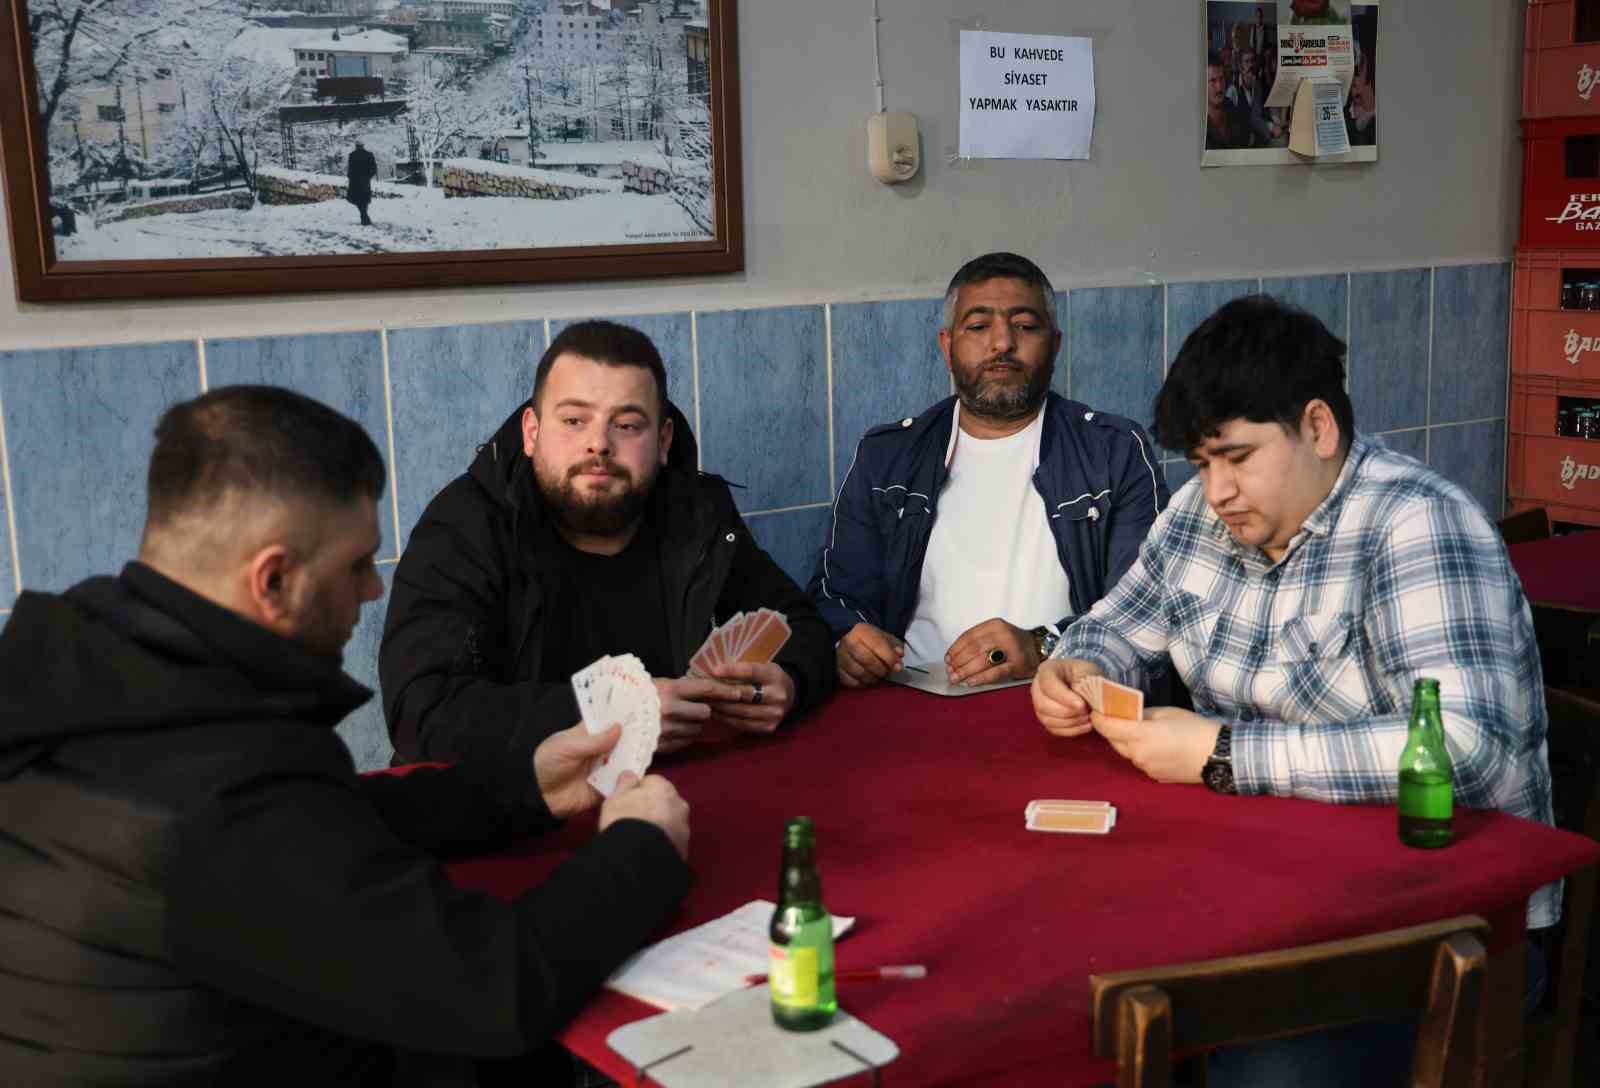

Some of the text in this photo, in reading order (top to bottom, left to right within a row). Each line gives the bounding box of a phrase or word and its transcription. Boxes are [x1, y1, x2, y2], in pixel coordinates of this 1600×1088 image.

[990, 46, 1064, 61] BU KAHVEDE
[1004, 70, 1048, 86] SİYASET
[970, 97, 1078, 111] YAPMAK YASAKTIR
